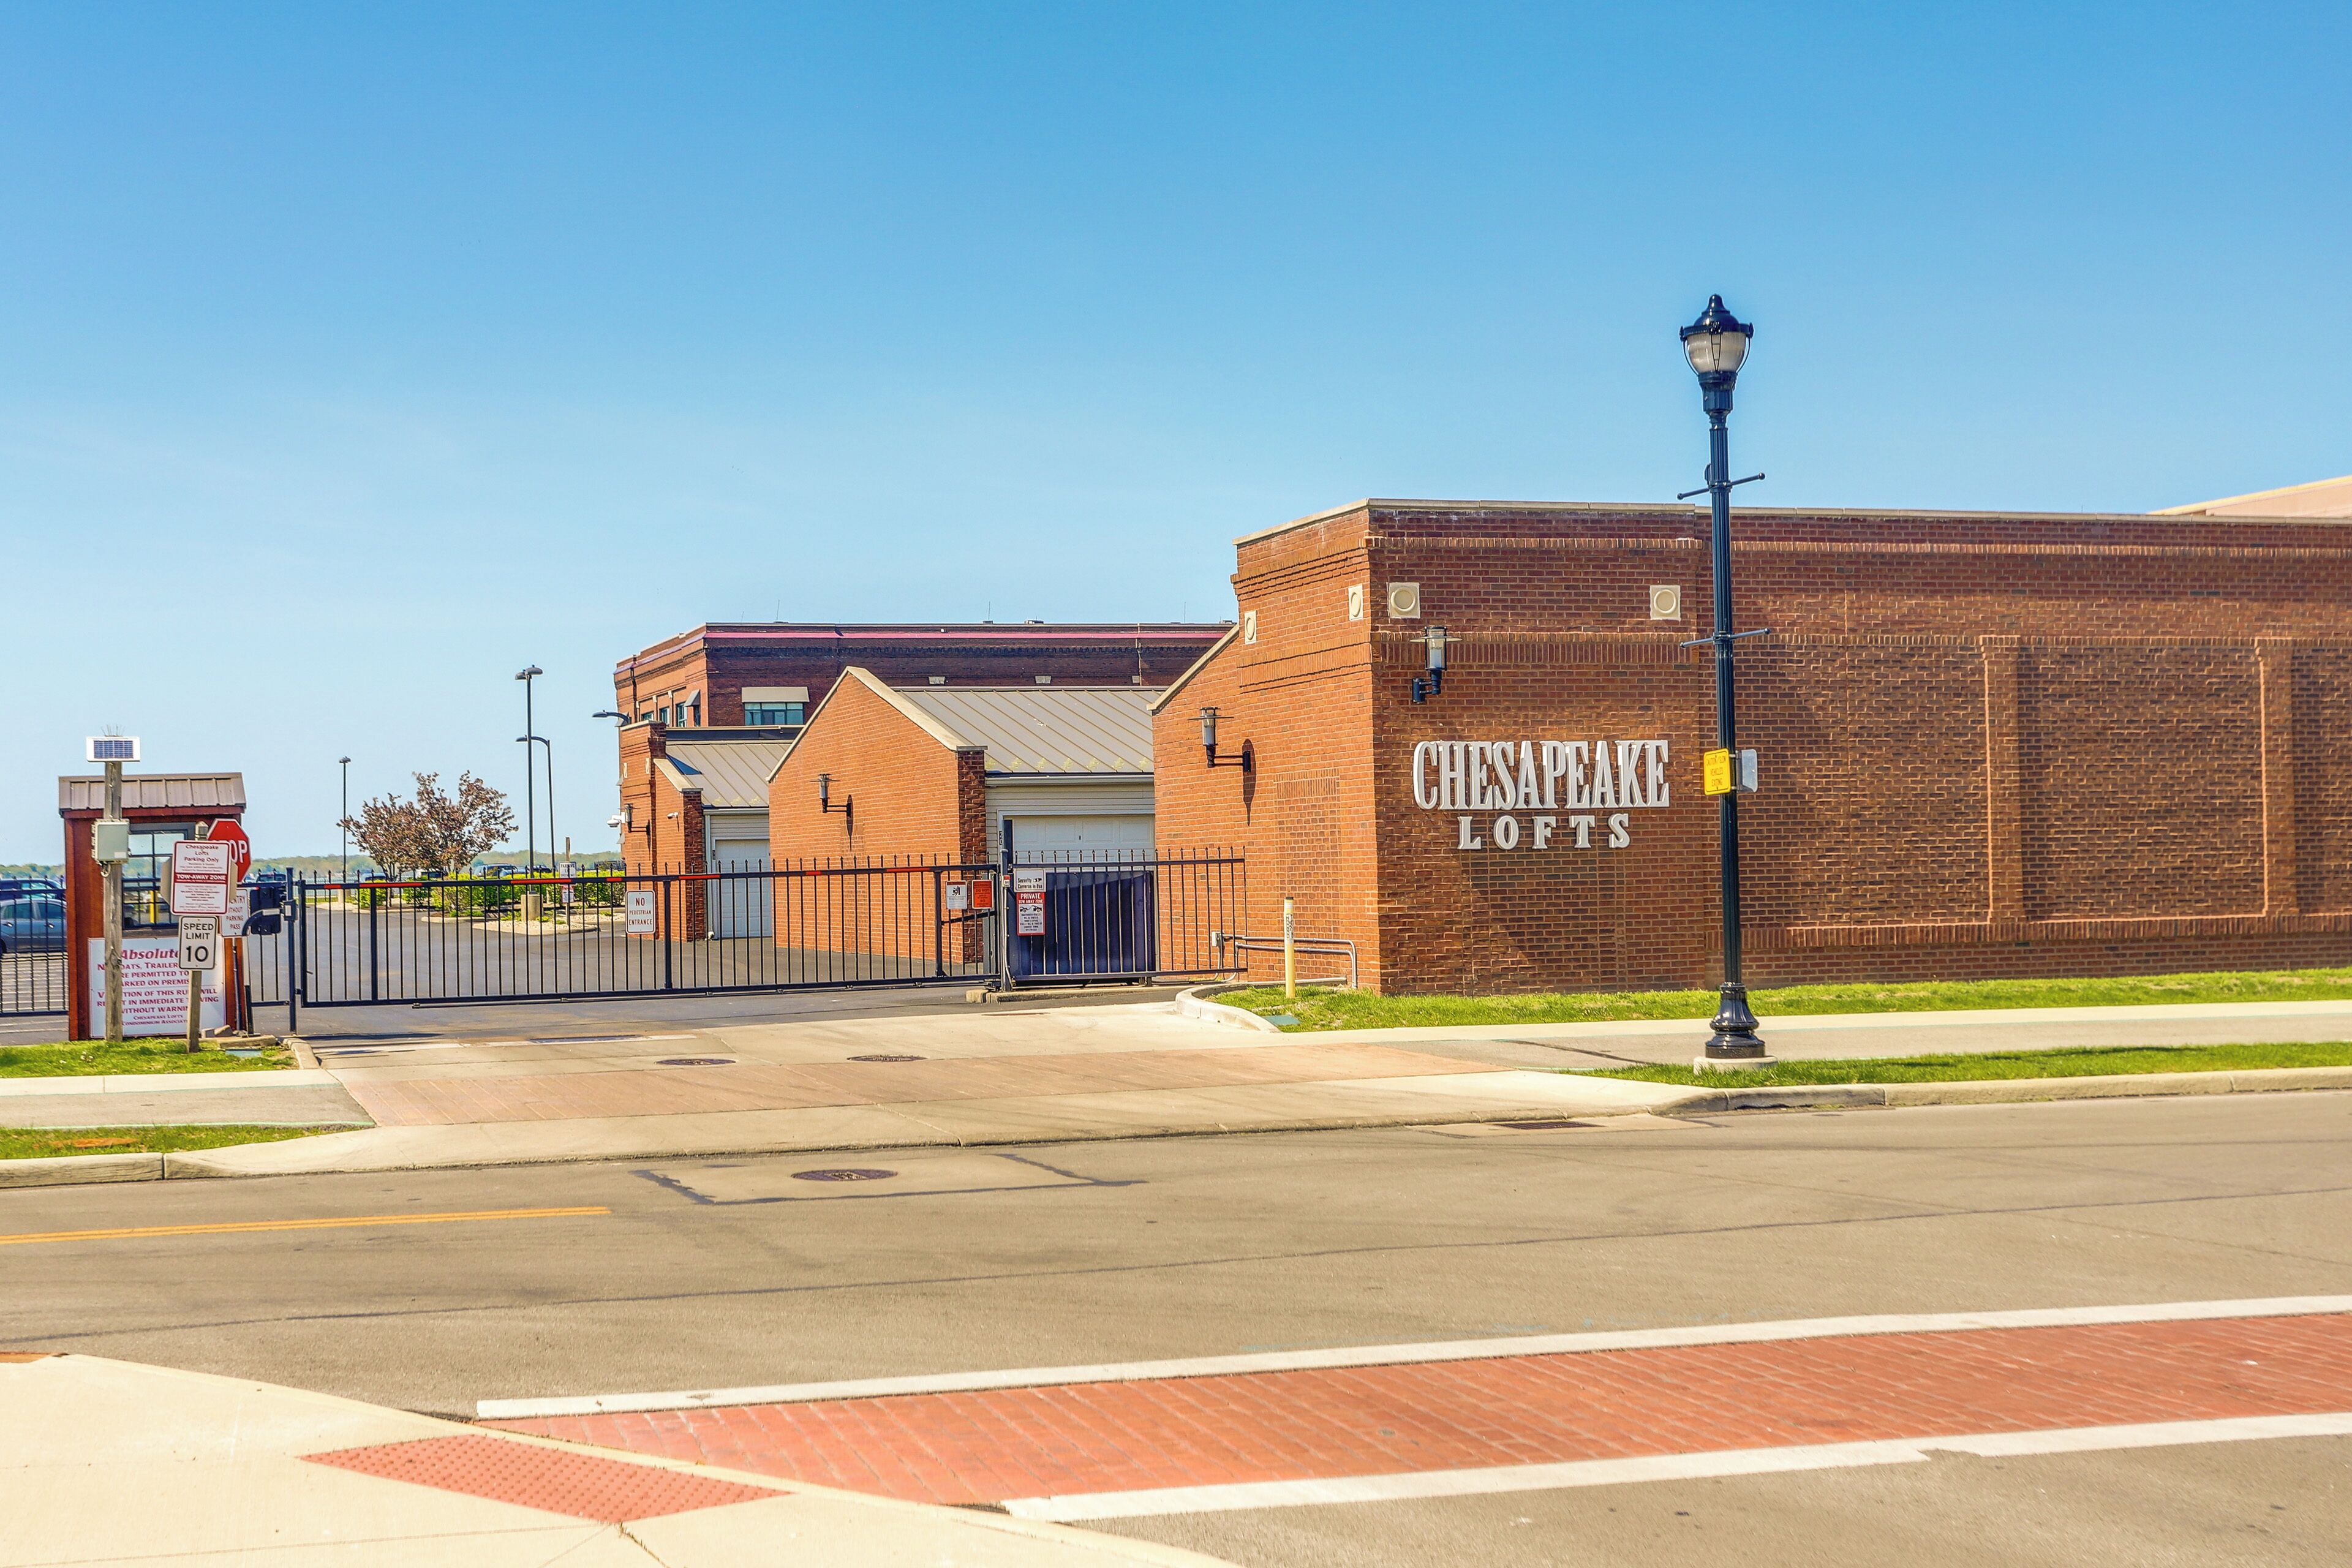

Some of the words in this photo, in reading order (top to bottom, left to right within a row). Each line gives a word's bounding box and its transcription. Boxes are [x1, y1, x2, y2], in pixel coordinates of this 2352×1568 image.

[1412, 739, 1670, 810] CHESAPEAKE
[1457, 813, 1632, 850] LOFTS
[230, 840, 247, 863] OP
[636, 897, 645, 907] NO
[186, 946, 209, 962] 10
